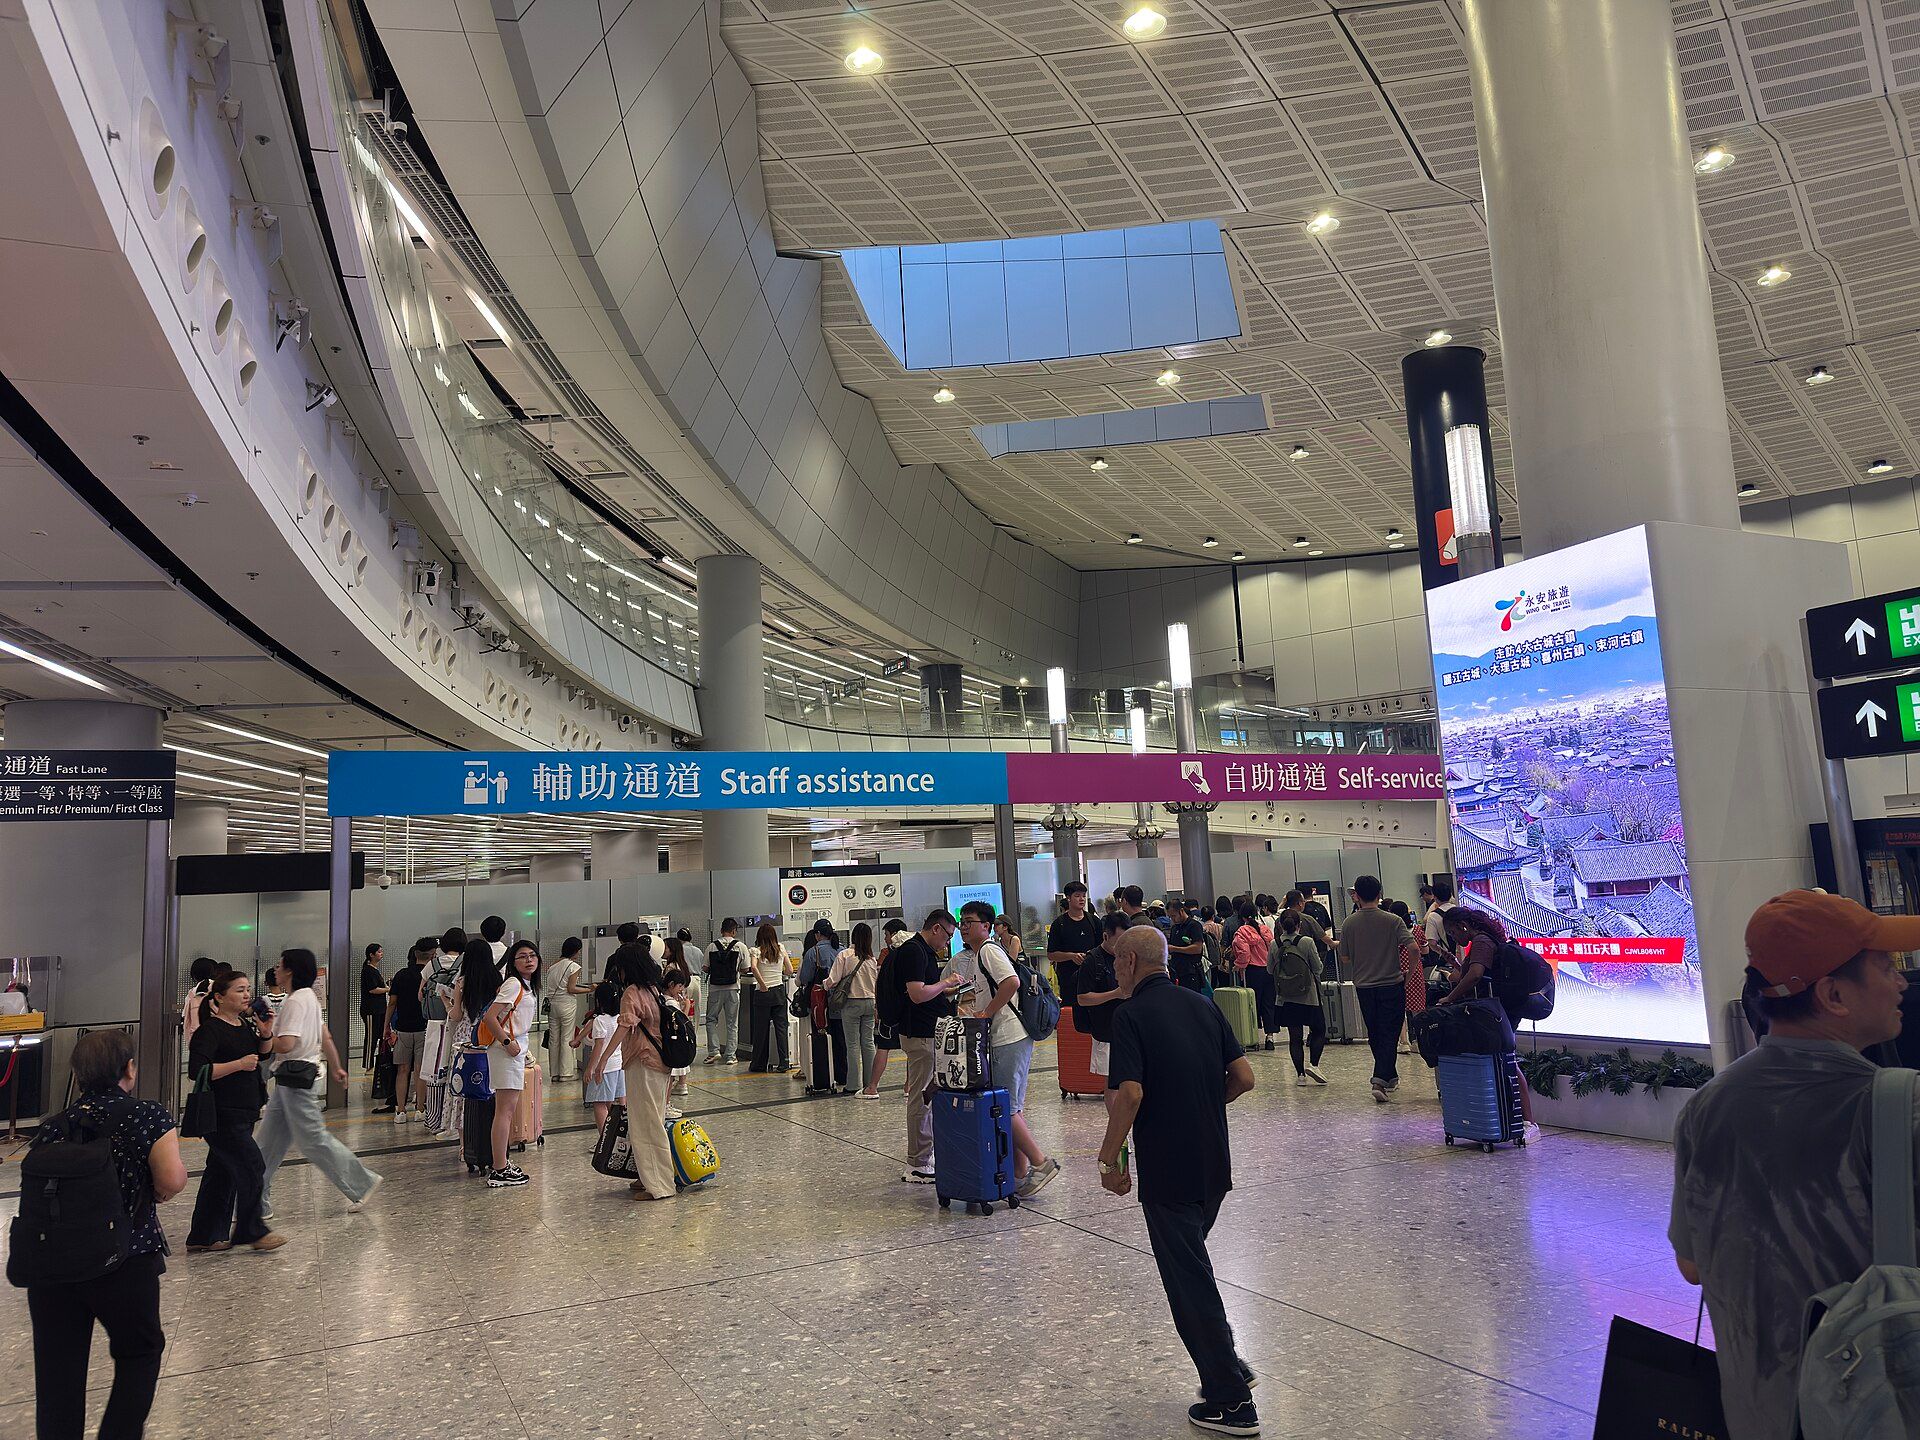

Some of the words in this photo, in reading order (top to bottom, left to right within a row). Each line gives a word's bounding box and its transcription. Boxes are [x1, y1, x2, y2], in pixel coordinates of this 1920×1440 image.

[1525, 585, 1570, 608] 永安旅遊
[1552, 599, 1571, 608] TRAVEL
[0, 755, 51, 776] 通道
[56, 765, 78, 774] Fast
[82, 765, 108, 774] Lane
[532, 762, 702, 802] 輔助通道
[720, 766, 790, 796] Staff
[796, 768, 935, 795] assistance
[1225, 761, 1328, 793] 自助通道
[1338, 766, 1443, 790] Self-service
[37, 805, 62, 815] First/
[65, 804, 114, 815] Premium/
[115, 803, 136, 814] First
[138, 803, 163, 814] Class
[881, 909, 886, 917] 6
[748, 918, 753, 926] 5
[598, 928, 604, 936] 4
